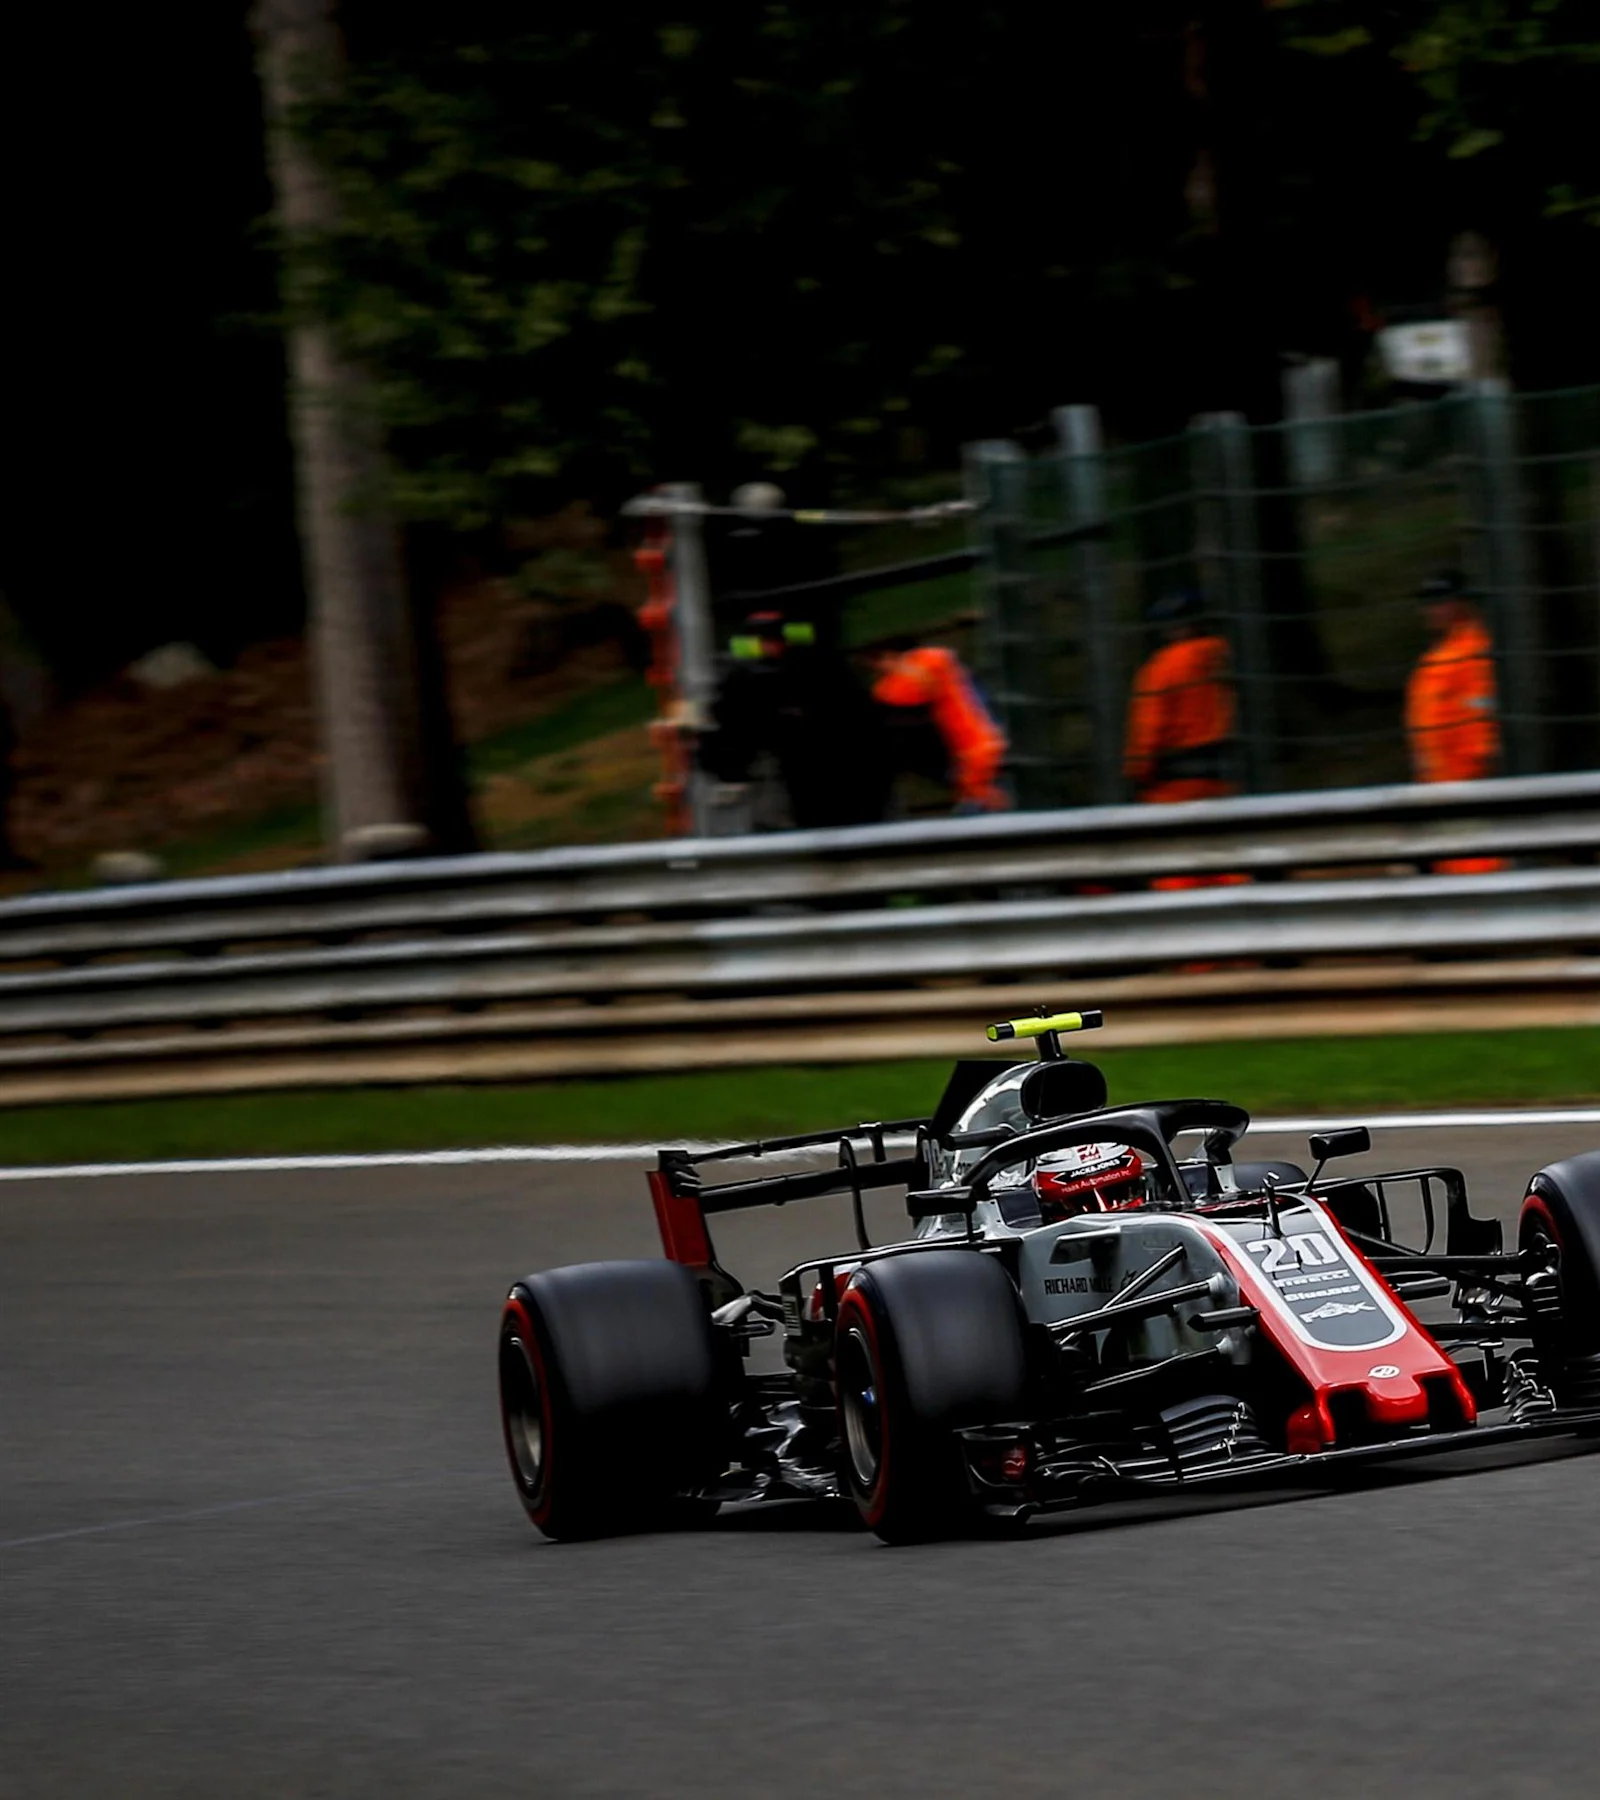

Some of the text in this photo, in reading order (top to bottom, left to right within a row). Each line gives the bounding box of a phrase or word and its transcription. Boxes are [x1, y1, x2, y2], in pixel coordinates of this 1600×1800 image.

[1080, 1171, 1121, 1188] Automation
[1246, 1233, 1340, 1273] 20
[1044, 1277, 1088, 1295] RICHARD
